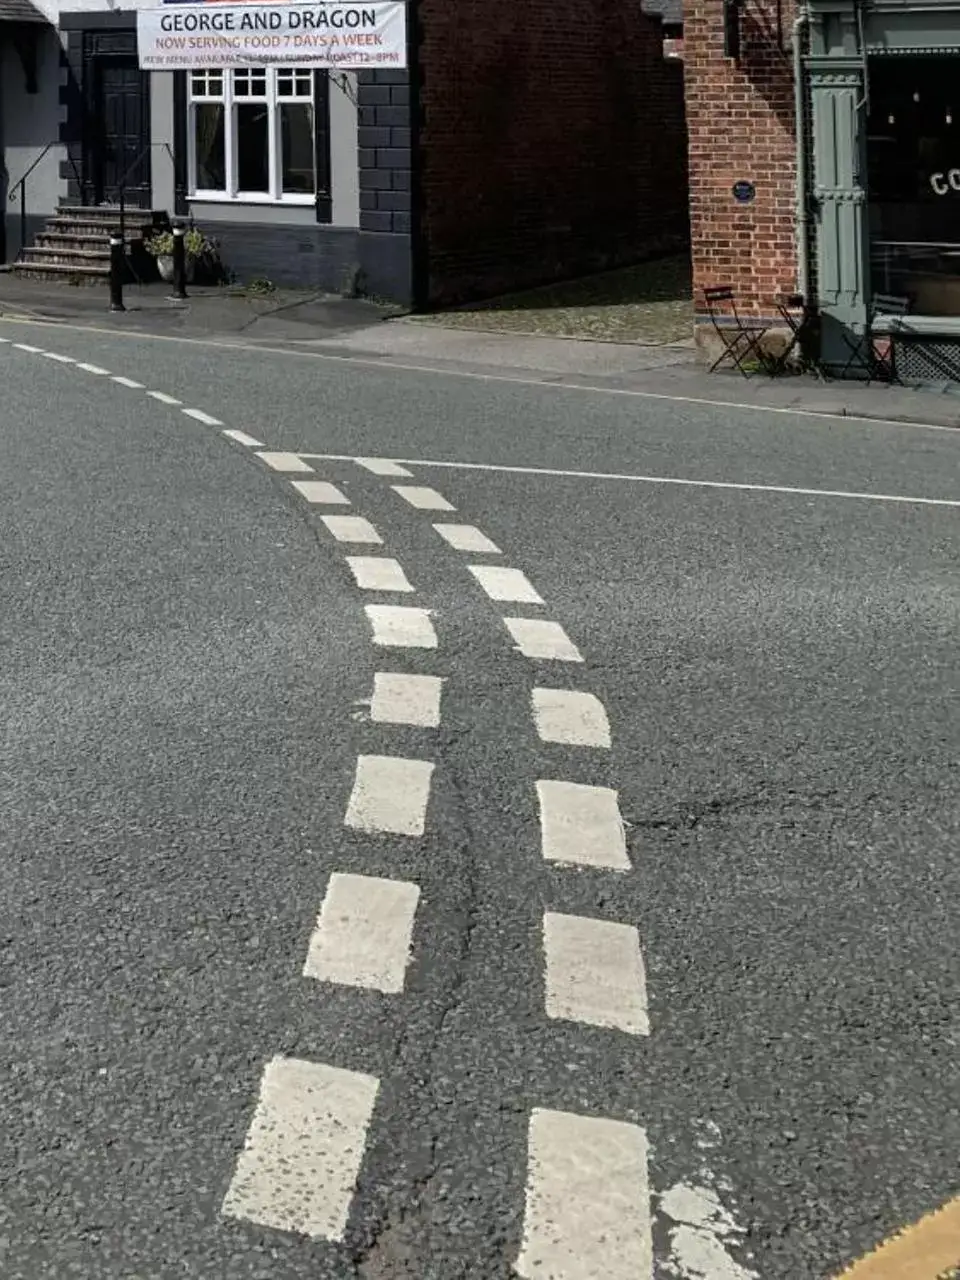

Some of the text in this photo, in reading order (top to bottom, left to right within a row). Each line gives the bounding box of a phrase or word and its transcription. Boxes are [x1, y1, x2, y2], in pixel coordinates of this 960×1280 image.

[160, 8, 377, 32] GEORGE AND DRAGON
[155, 32, 383, 49] NOW SERVING FOOD 7 DAYS A WEEK
